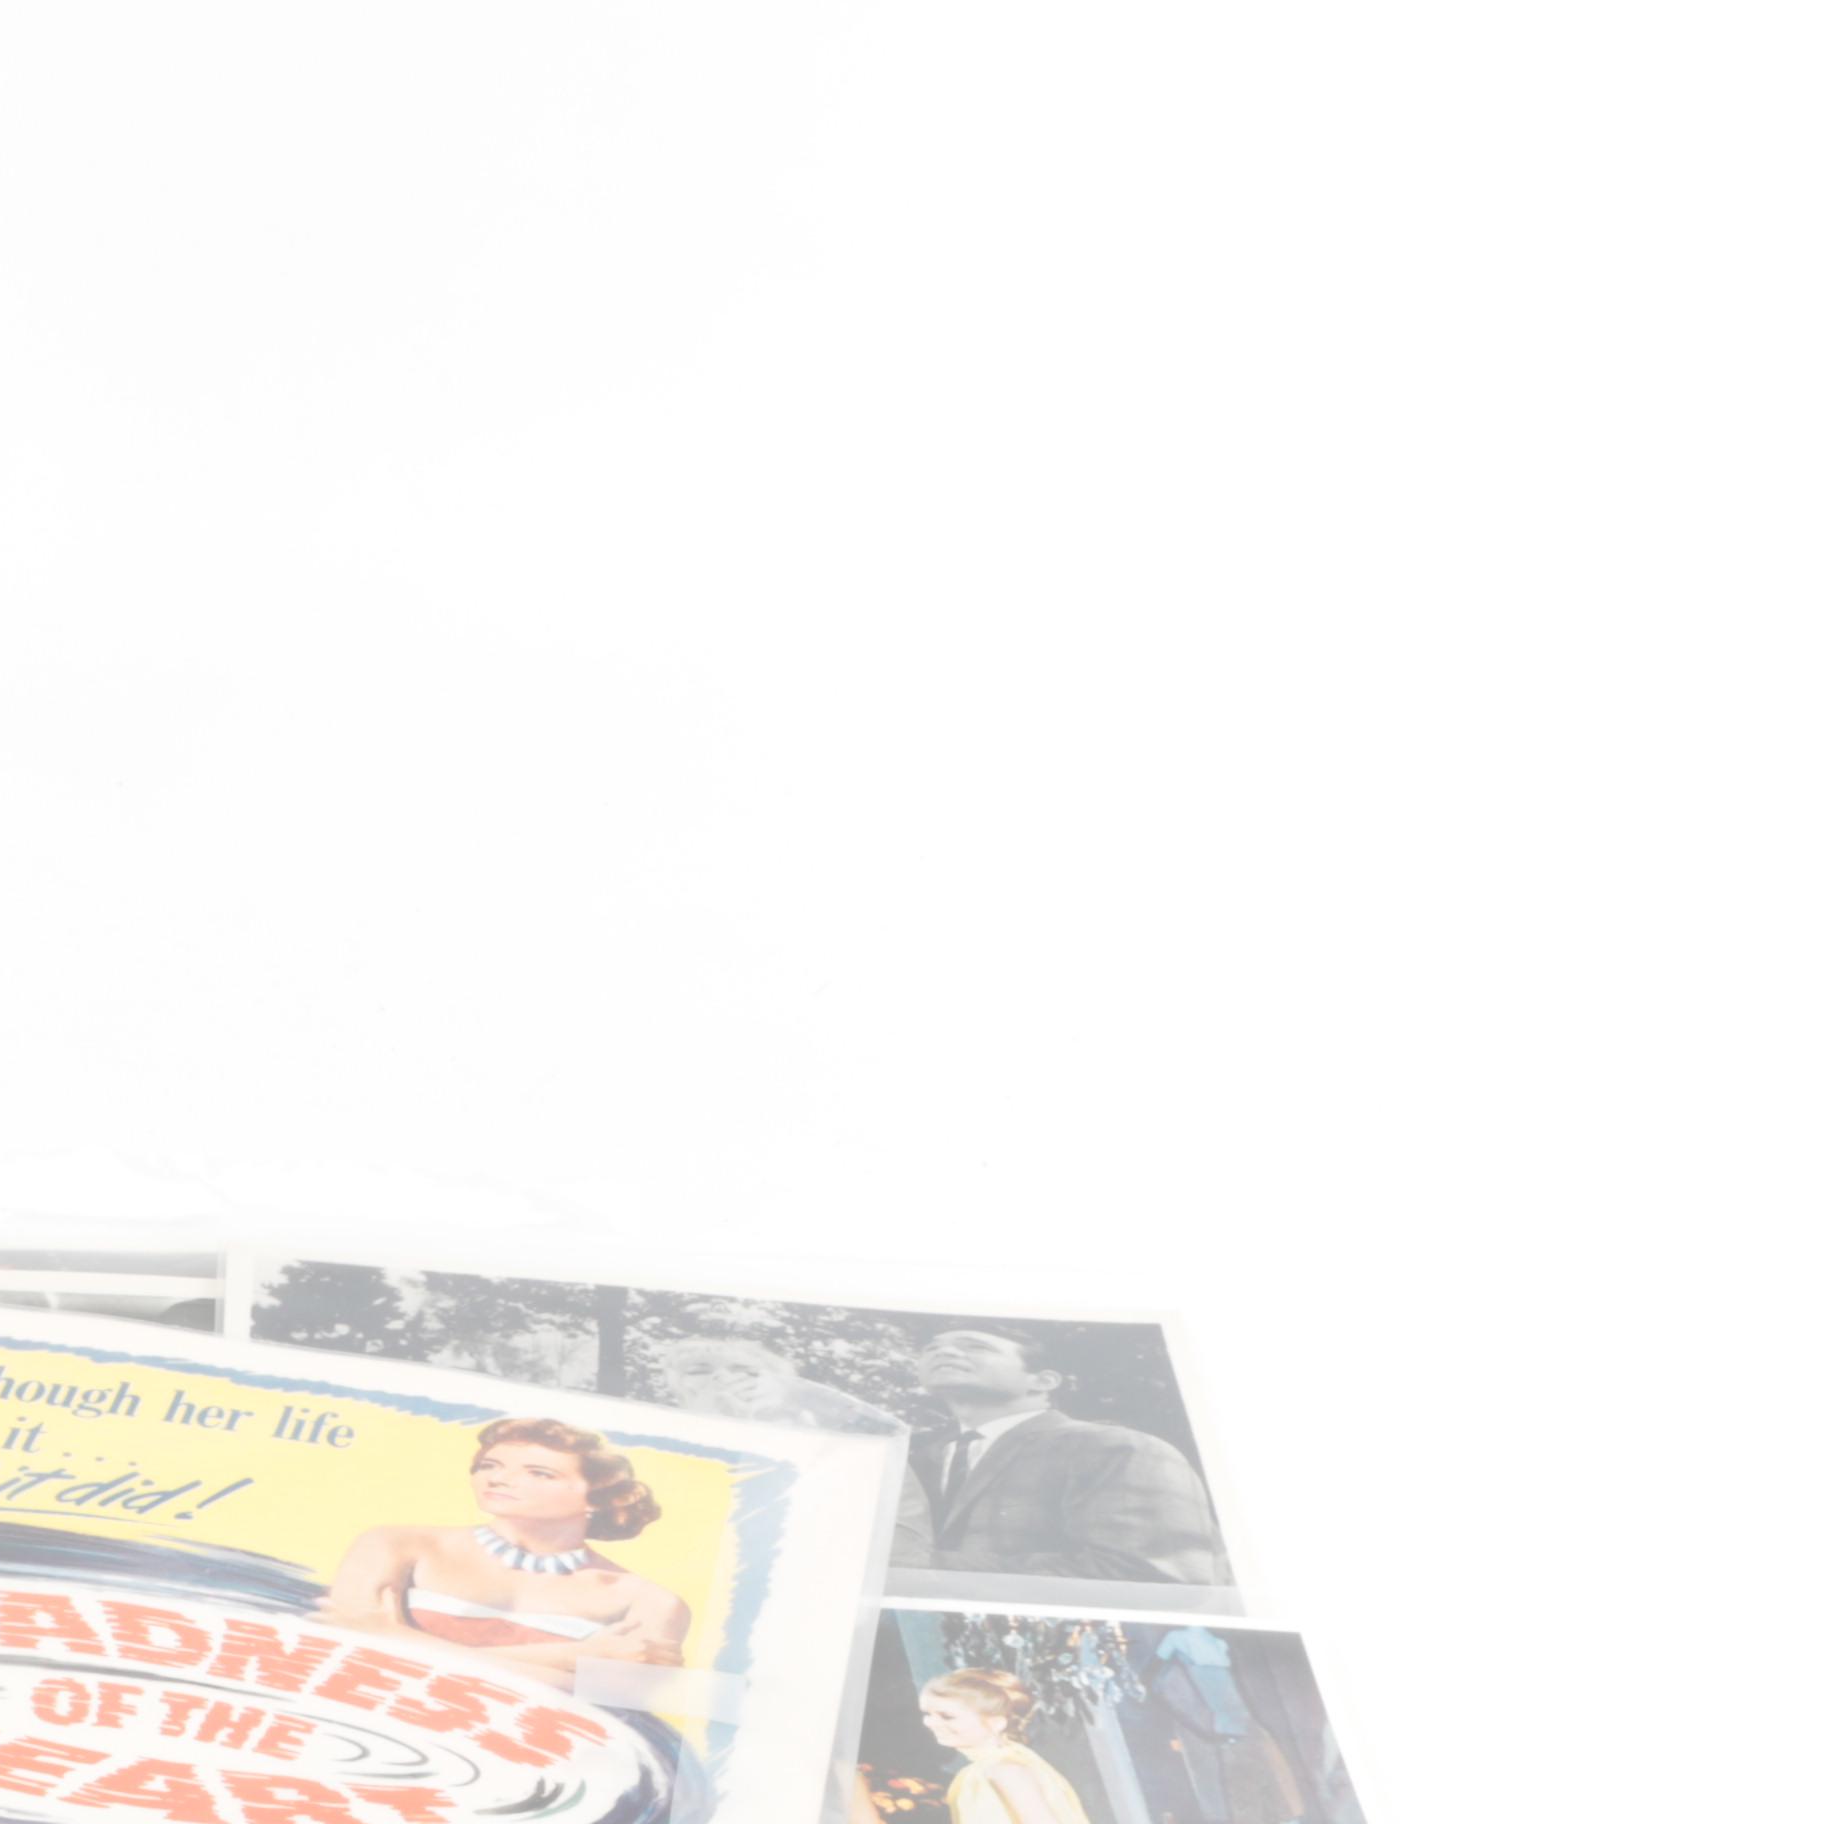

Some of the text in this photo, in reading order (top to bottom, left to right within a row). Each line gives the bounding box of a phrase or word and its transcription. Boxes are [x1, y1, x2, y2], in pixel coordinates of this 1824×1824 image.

[164, 1389, 253, 1433] her
[271, 1403, 356, 1450] life
[71, 1476, 253, 1521] did!
[31, 1677, 318, 1761] OF THE
